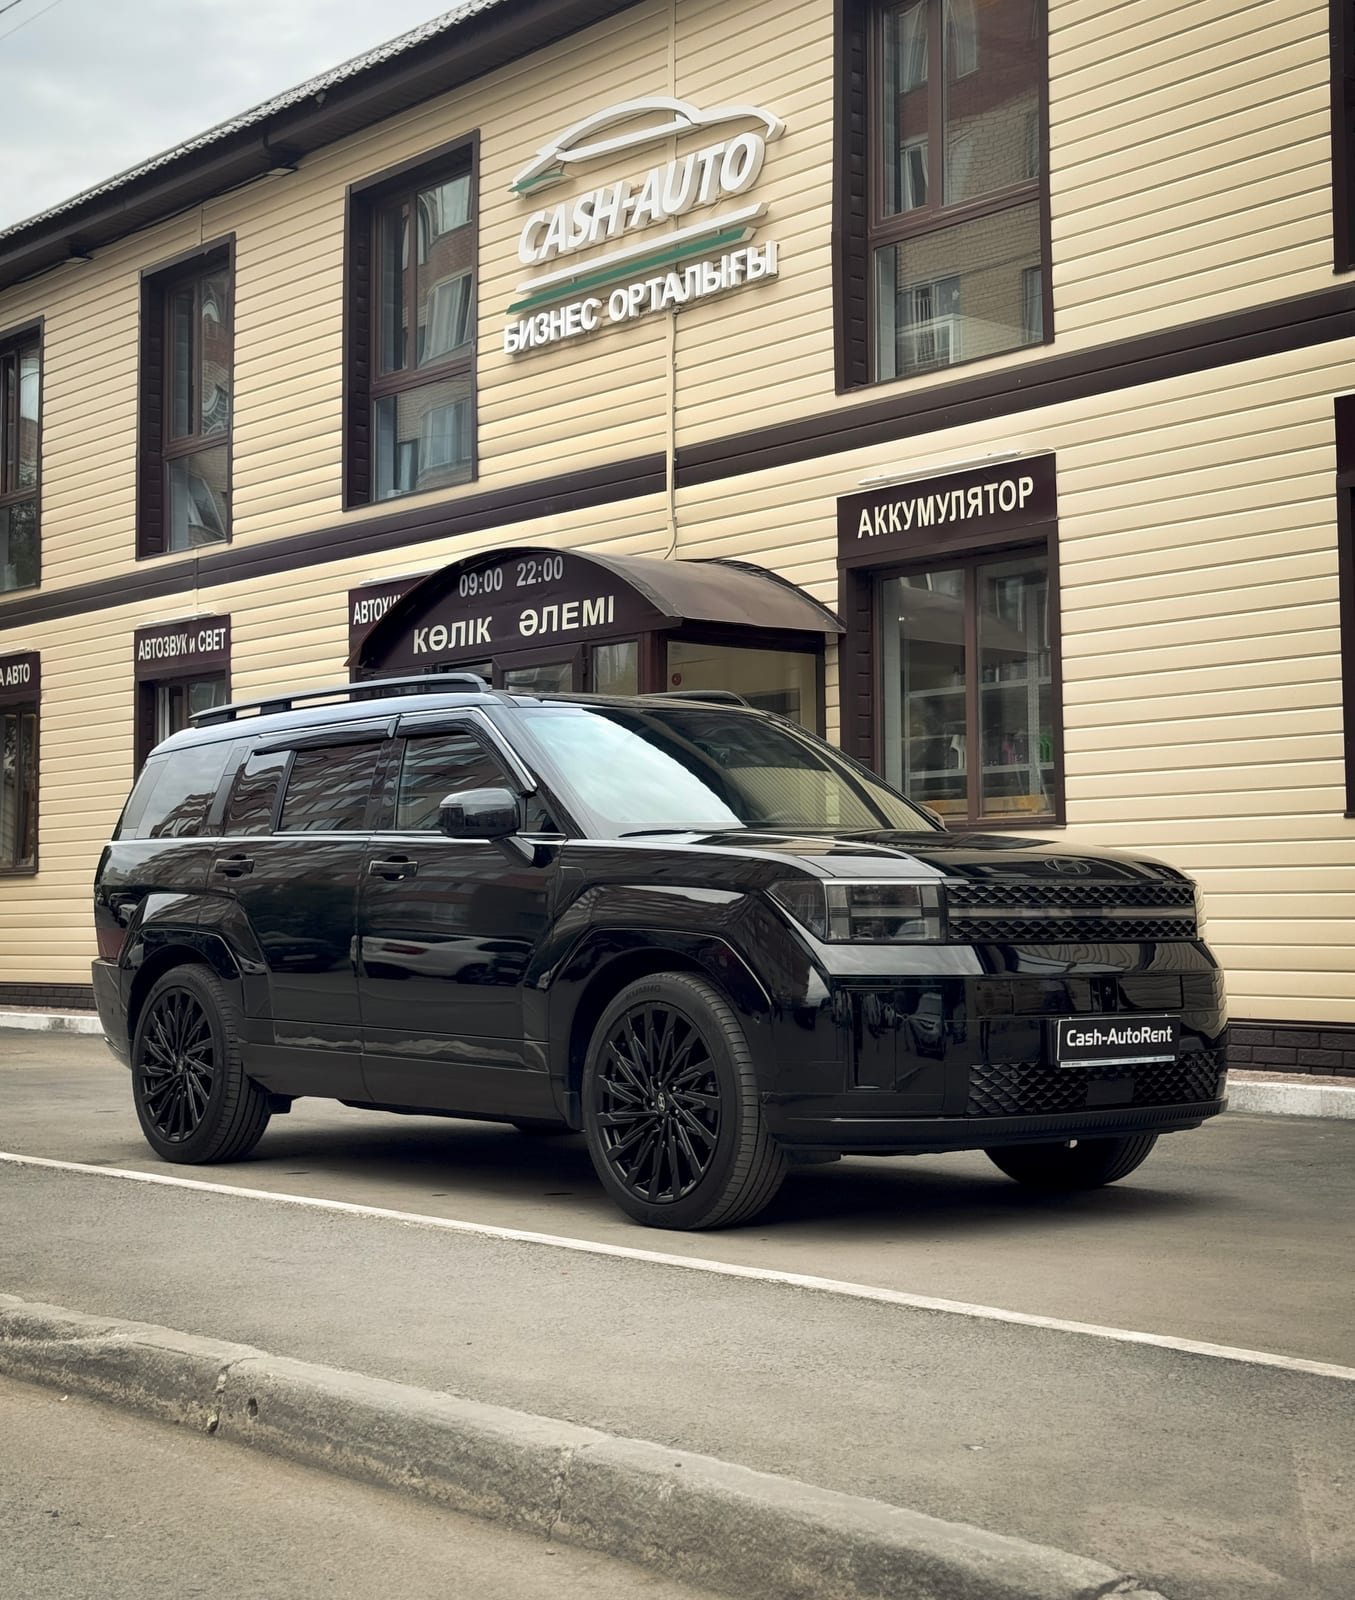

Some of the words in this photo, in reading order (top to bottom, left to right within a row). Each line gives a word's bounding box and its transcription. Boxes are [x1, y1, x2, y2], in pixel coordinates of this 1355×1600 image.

[518, 132, 766, 265] CASH-AUTO
[503, 297, 602, 355] БИЗНЕС
[608, 240, 779, 322] ОРТАЛЫҒЫ
[857, 476, 1035, 539] АККУМУЛЯТОР
[458, 567, 503, 598] 09:00
[516, 555, 564, 588] 22:00
[353, 594, 401, 625] АВТОХ
[413, 616, 493, 655] КӨЛІК
[518, 595, 615, 637] ӘЛЕМІ
[138, 633, 189, 661] АВТОЗВУК
[198, 628, 227, 652] СВЕТ
[5, 663, 31, 687] АВТО
[1066, 1025, 1173, 1047] Cash-AutoRent
